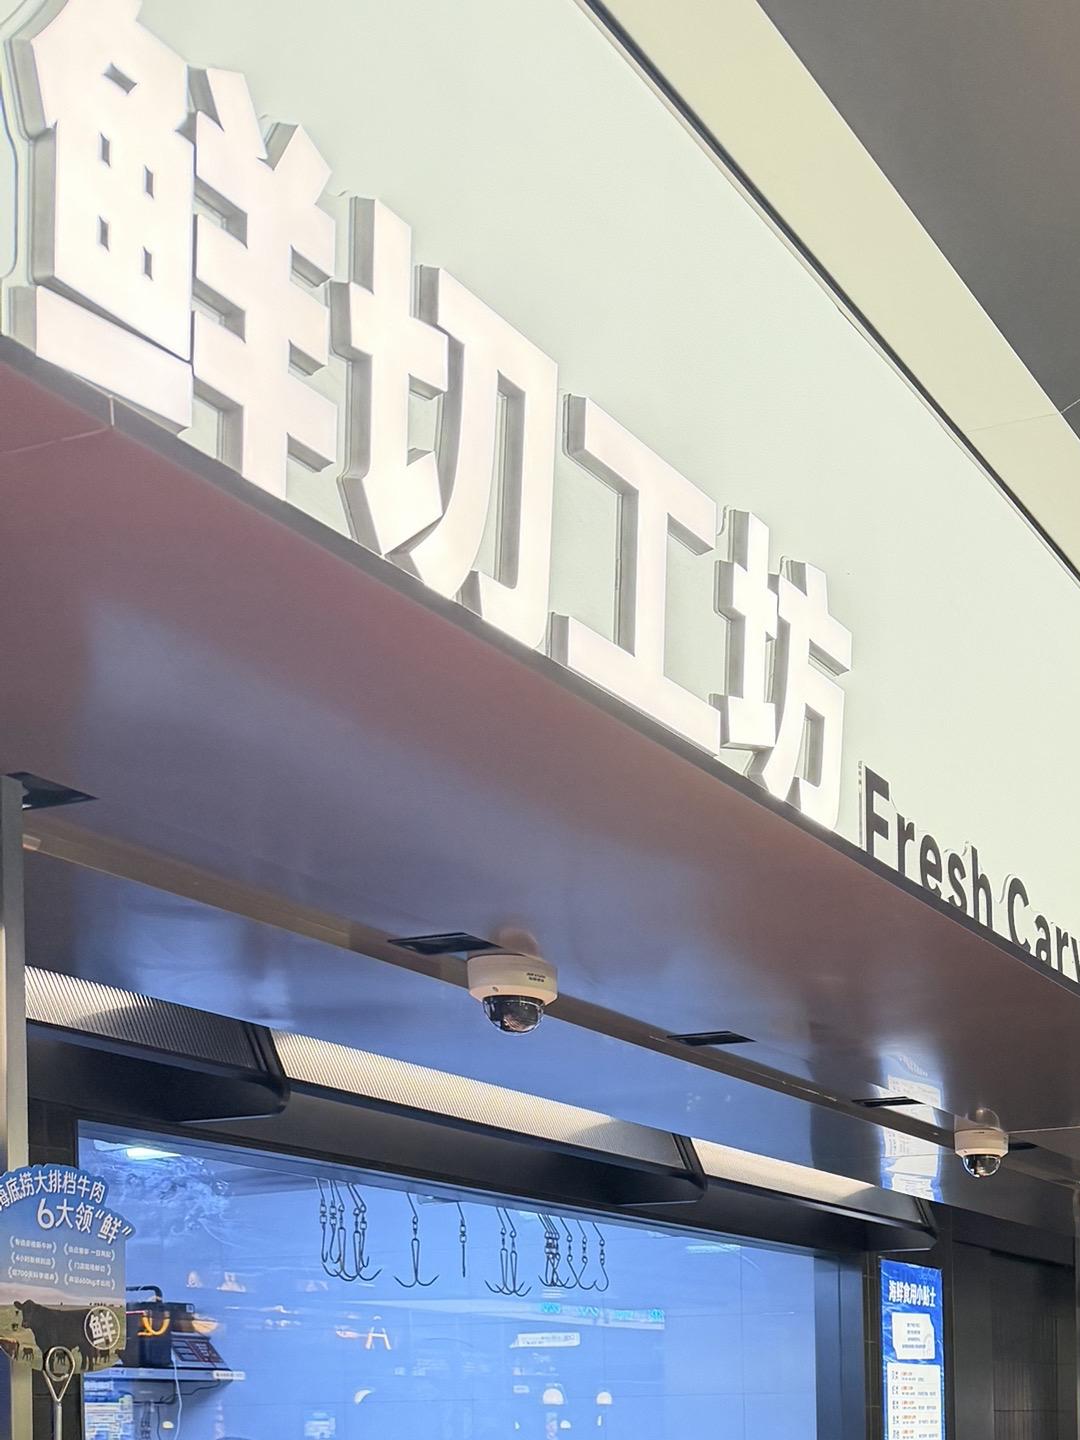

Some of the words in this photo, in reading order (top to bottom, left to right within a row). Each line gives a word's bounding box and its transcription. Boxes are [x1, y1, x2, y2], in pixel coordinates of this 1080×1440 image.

[12, 0, 852, 831] 鲜切工坊
[862, 763, 994, 931] Fresh
[0, 1169, 106, 1211] 海底捞大排档牛肉
[888, 1279, 937, 1308] 海鲜食用小贴士
[88, 1313, 118, 1346] 鲜
